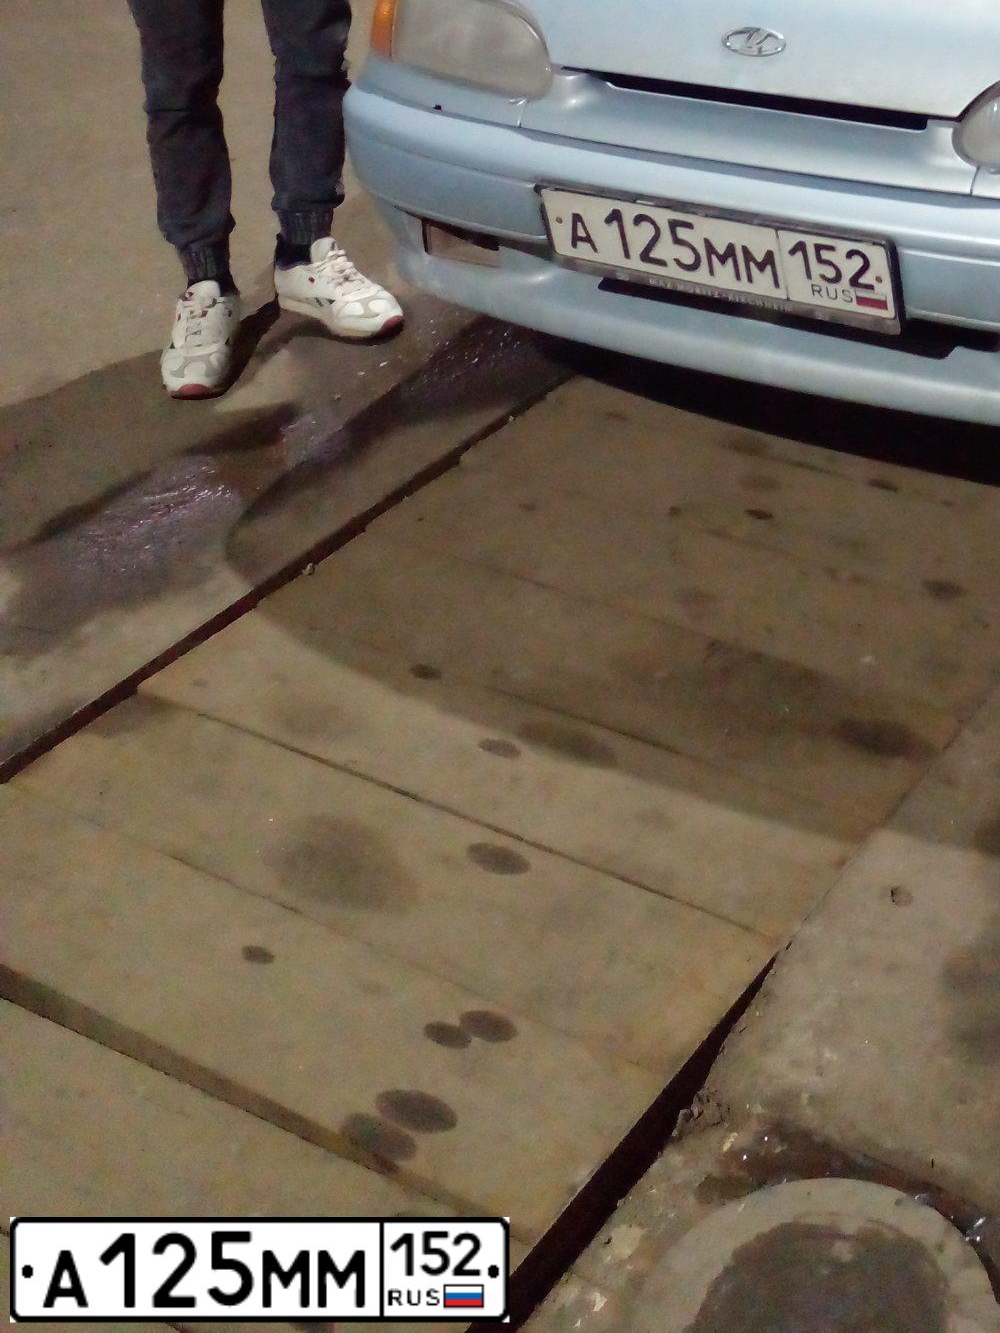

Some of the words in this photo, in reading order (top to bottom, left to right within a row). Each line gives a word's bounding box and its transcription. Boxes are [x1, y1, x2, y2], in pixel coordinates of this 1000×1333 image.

[570, 208, 780, 289] А125ММ
[788, 240, 875, 290] 152
[811, 283, 854, 303] RUS
